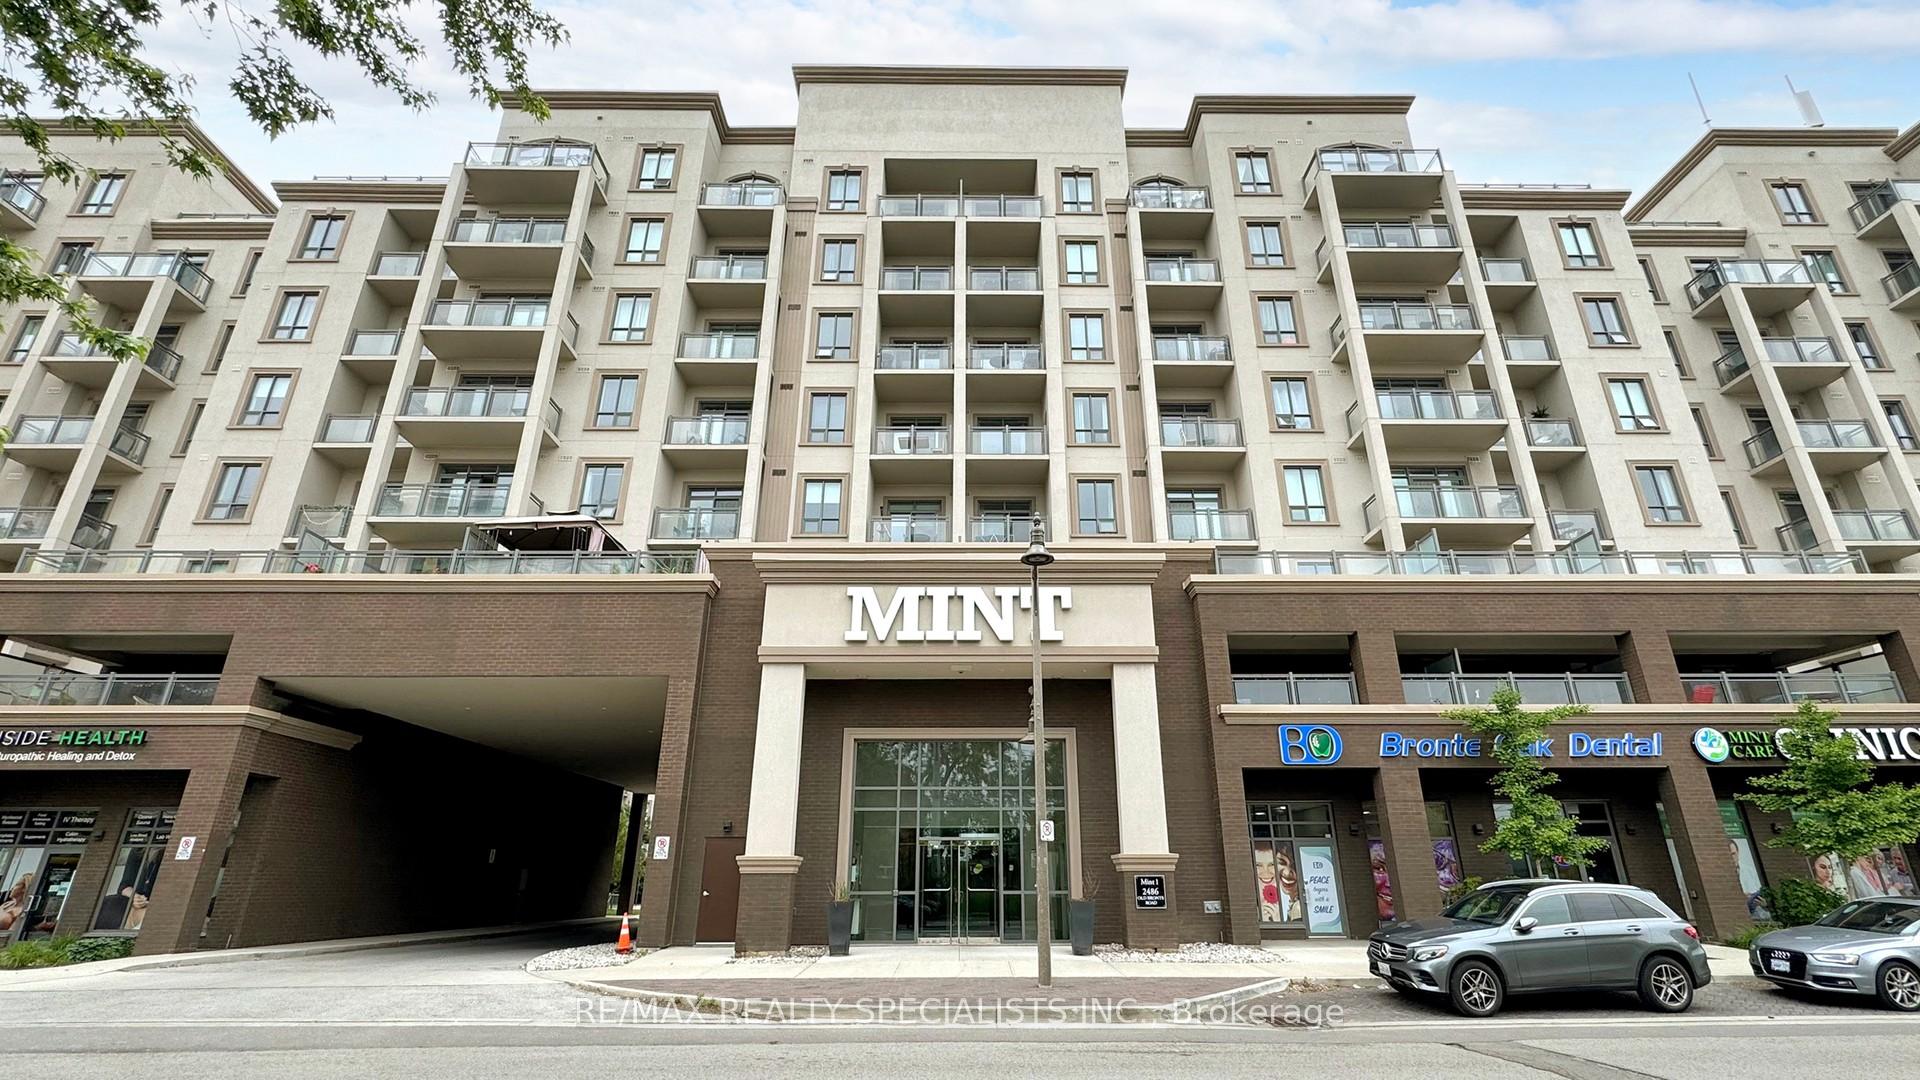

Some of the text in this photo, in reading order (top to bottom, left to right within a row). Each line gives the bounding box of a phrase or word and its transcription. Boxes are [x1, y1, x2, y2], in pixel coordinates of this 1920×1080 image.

[844, 586, 1072, 641] MINT
[58, 730, 146, 746] HEALTH
[1728, 731, 1770, 744] MINT
[1379, 732, 1481, 757] Bronte
[1568, 732, 1663, 757] Dental
[47, 751, 84, 763] Healing
[85, 751, 105, 761] and
[106, 751, 136, 761] Detox
[1732, 744, 1778, 758] CARE
[71, 816, 95, 824] Therapy
[1309, 876, 1331, 885] PEACE
[1142, 887, 1160, 896] 2486
[1313, 905, 1335, 914] SMILE
